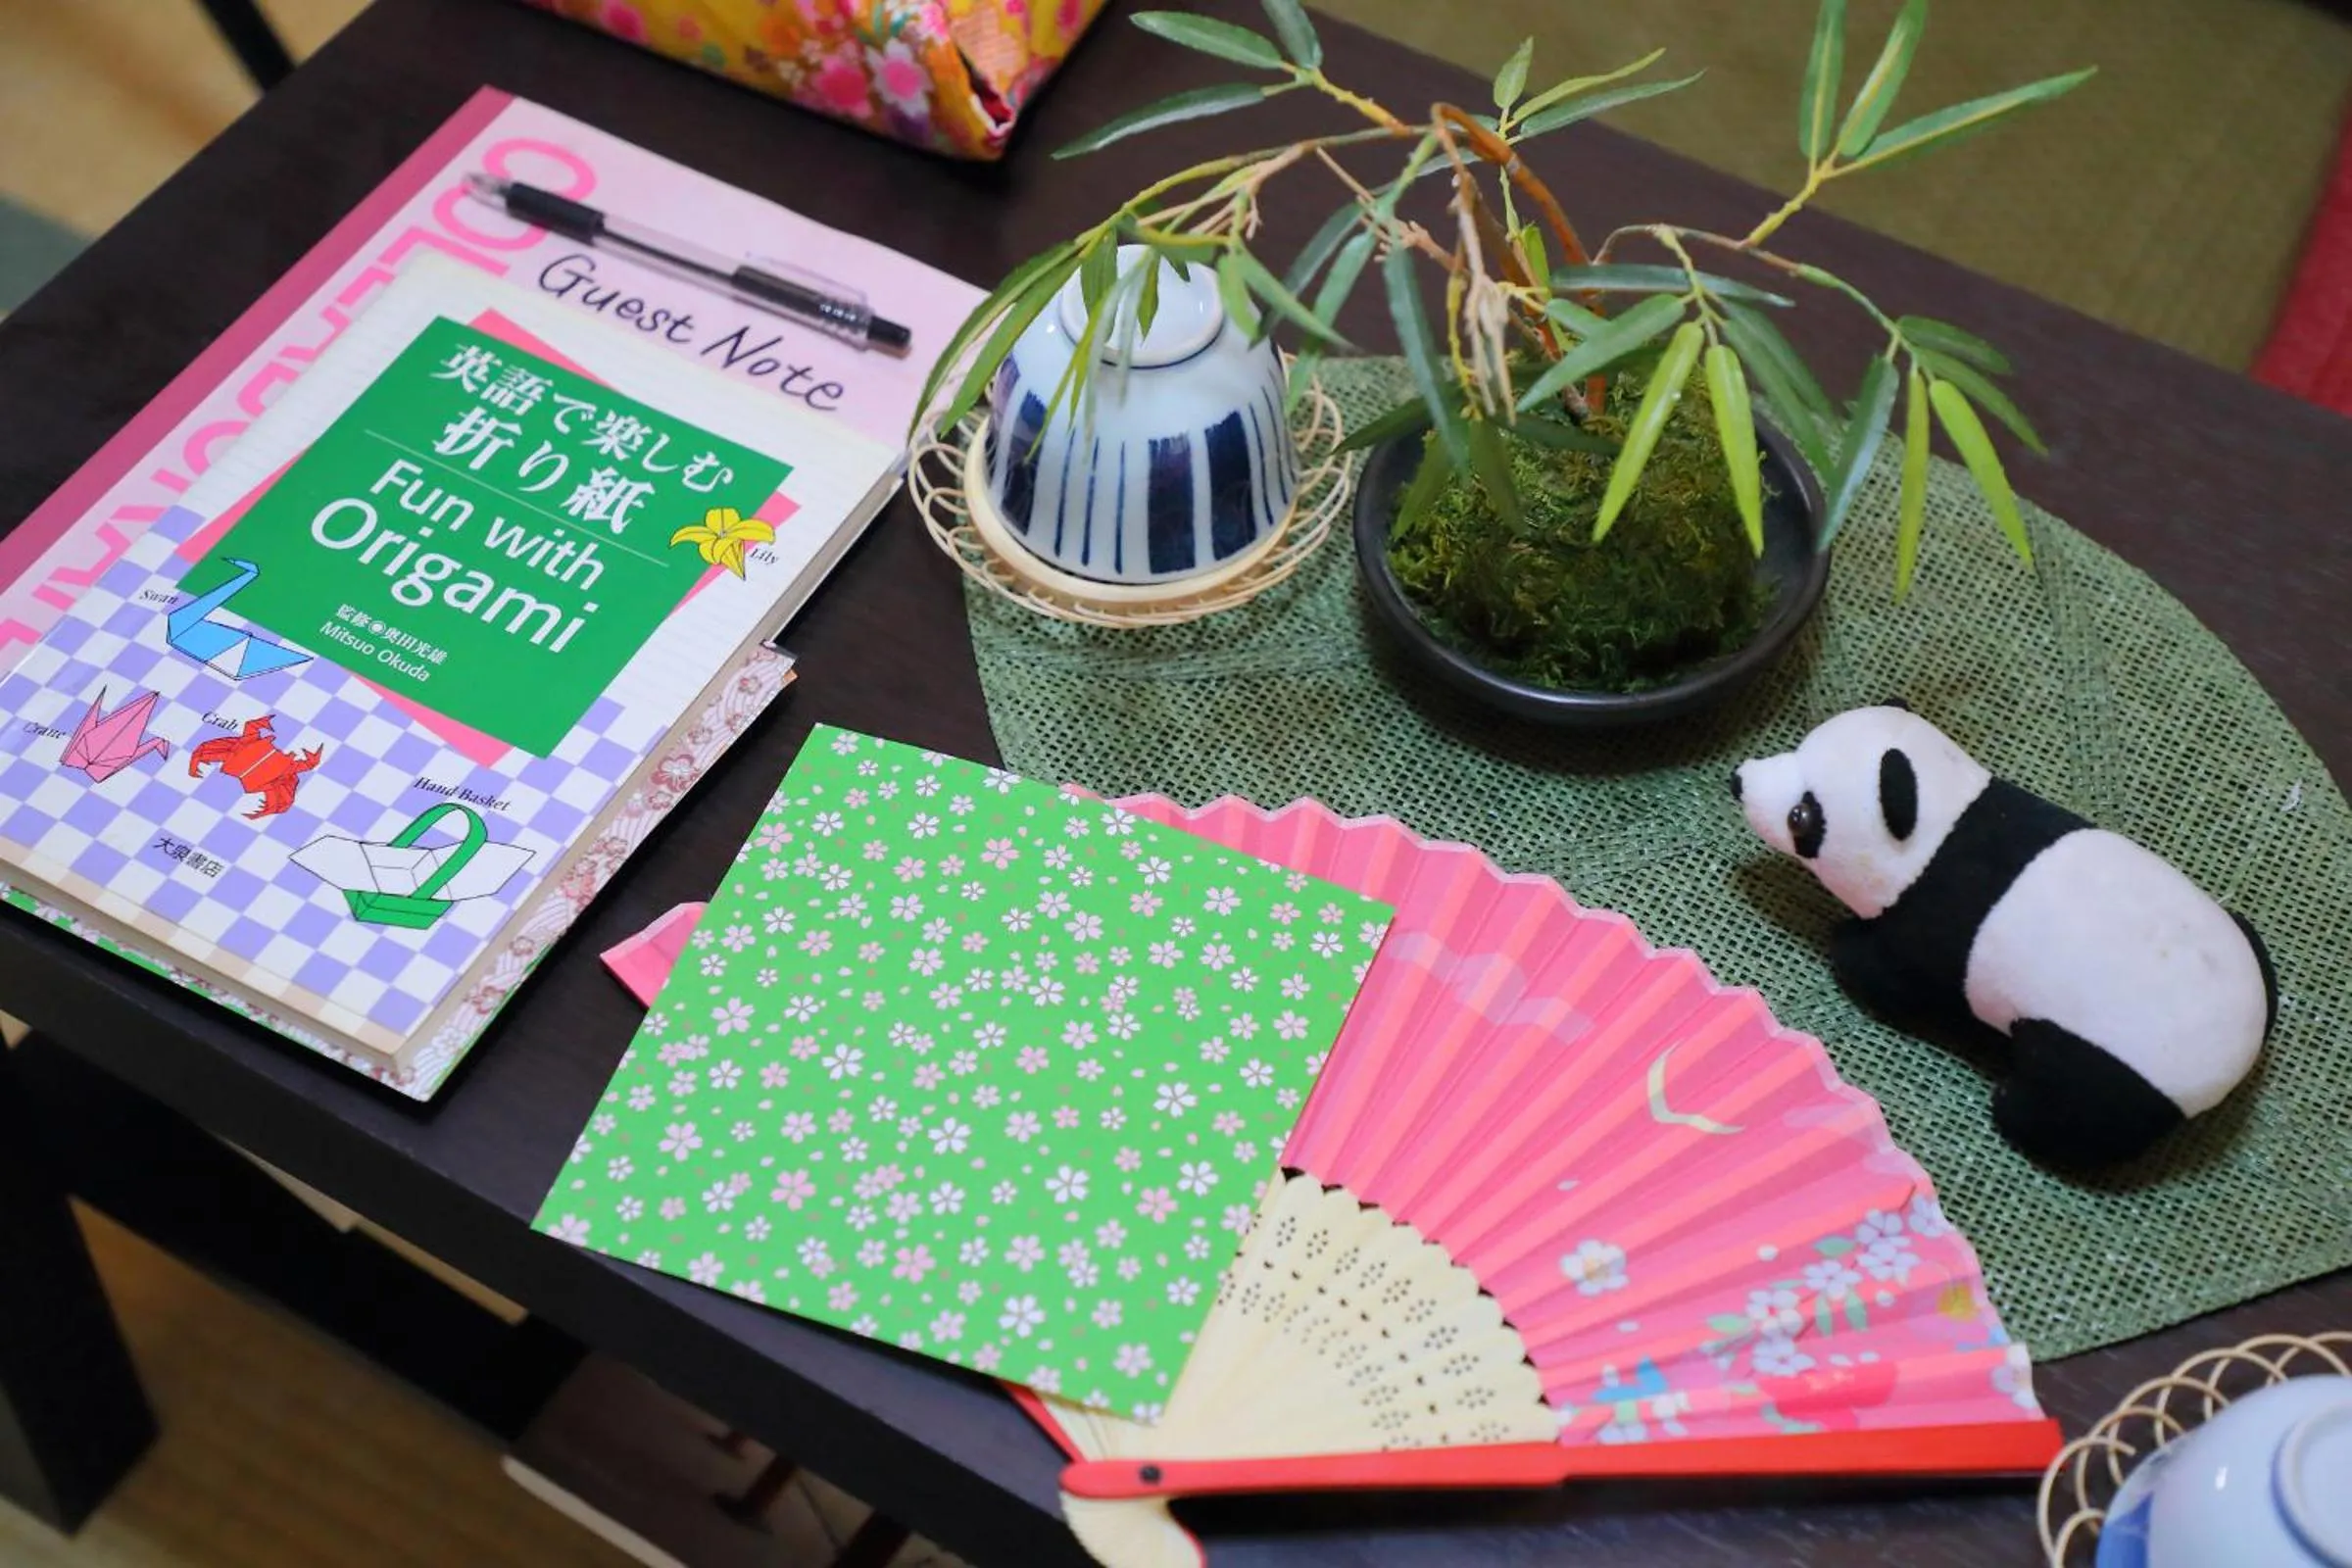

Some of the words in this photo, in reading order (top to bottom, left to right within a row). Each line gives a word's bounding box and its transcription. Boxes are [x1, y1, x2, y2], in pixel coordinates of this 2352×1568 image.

[538, 253, 696, 344] Guest
[700, 324, 845, 413] Note
[429, 344, 734, 493] 英語で楽しむ
[432, 405, 656, 535] 折り紙
[369, 458, 475, 532] Fun
[483, 515, 605, 591] with
[310, 497, 600, 654] Origami
[750, 548, 779, 565] Lily
[138, 589, 179, 606] Swan
[318, 620, 375, 656] Mitsuo
[376, 649, 431, 682] Okuda
[23, 721, 67, 740] Crane
[201, 711, 238, 731] Crab
[413, 775, 458, 798] Hand
[458, 787, 511, 811] Basket
[152, 836, 225, 879] 大泉書店
